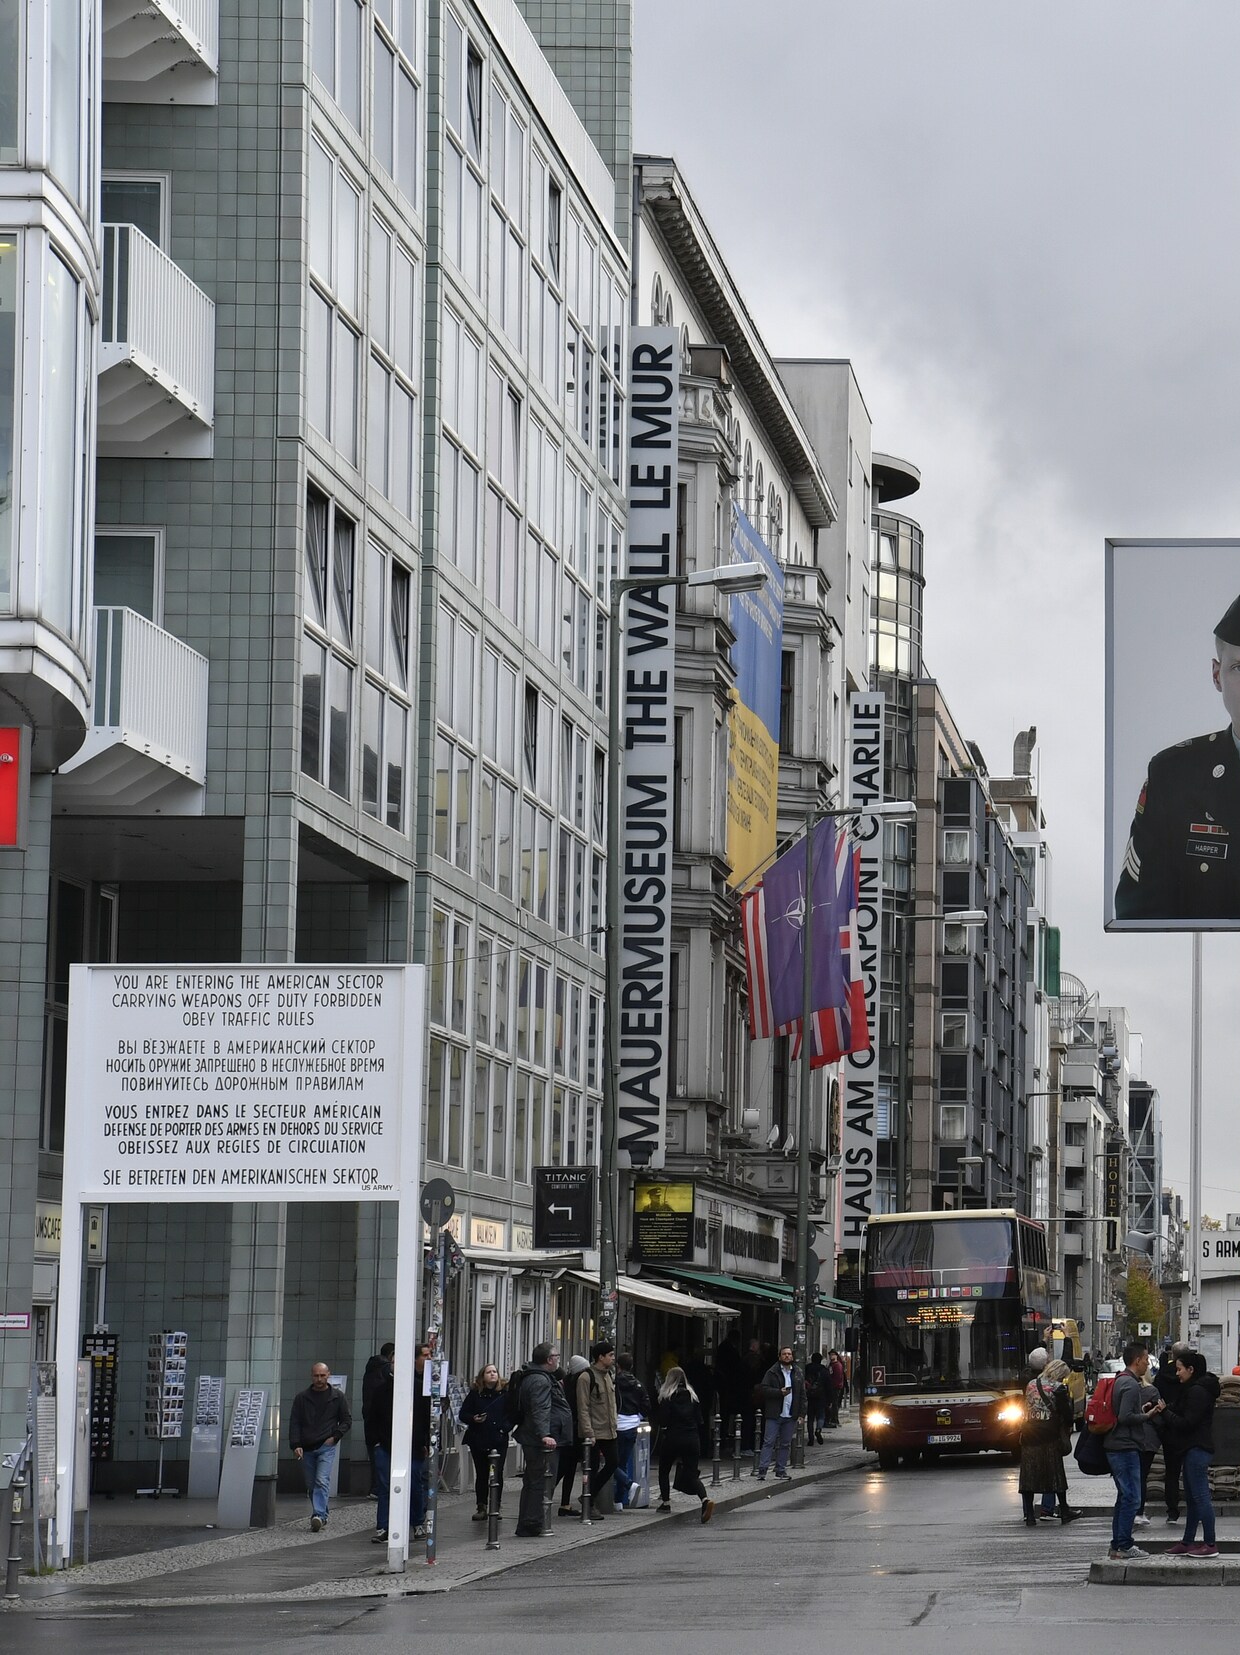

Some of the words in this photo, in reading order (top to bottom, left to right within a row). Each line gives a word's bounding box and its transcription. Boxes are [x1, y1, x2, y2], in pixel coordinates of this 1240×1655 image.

[631, 344, 673, 448] MUR
[631, 465, 671, 508] LE
[628, 533, 670, 655] WALL
[626, 670, 667, 749] THE
[852, 704, 880, 841] CHARLIE
[1195, 844, 1218, 854] HARPER
[619, 775, 668, 1149] MAUERMUSEUM
[114, 975, 138, 989] YOU
[146, 975, 168, 989] ARE
[177, 975, 233, 989] ENTERING
[241, 975, 259, 989] THE
[267, 975, 329, 989] AMERICAN
[337, 975, 383, 989] SECTOR
[113, 994, 176, 1008] CARRYING
[182, 994, 242, 1008] WEAPONS
[248, 994, 270, 1007] OFF
[278, 993, 307, 1007] DUTY
[314, 993, 381, 1007] FORBIDDEN
[183, 1012, 215, 1026] OBEY
[222, 1012, 270, 1026] TRAFFIC
[278, 1012, 314, 1026] RULES
[119, 1040, 137, 1054] ВЫ
[227, 1038, 325, 1054] АМЕРИКАНСКИЙ
[332, 1040, 375, 1054] СЕКТОР
[106, 1059, 145, 1072] НОСИТЬ
[149, 1058, 191, 1072] ОРУЖИЕ
[272, 1058, 346, 1072] НЕСЛУЖЕБНОЕ
[351, 1058, 384, 1072] ВРЕМЯ
[215, 1076, 288, 1091] ДОРОЖНЫМ
[296, 1077, 363, 1090] ПРАВИЛАМ
[105, 1105, 137, 1119] VOUS
[146, 1105, 189, 1119] ENTREZ
[197, 1104, 228, 1118] DANS
[236, 1105, 246, 1118] LE
[253, 1104, 306, 1118] SECTEUR
[847, 1080, 874, 1136] AM
[104, 1123, 146, 1136] DEFENSE
[150, 1123, 162, 1136] DE
[165, 1122, 201, 1136] PORTER
[205, 1122, 223, 1136] DES
[226, 1122, 259, 1136] ARMES
[263, 1122, 276, 1135] EN
[281, 1122, 319, 1135] DEHORS
[325, 1122, 338, 1135] DU
[342, 1122, 383, 1135] SERVICE
[118, 1140, 178, 1154] OBEISSEZ
[186, 1140, 210, 1154] AUX
[218, 1140, 259, 1154] REGLES
[268, 1140, 281, 1153] DE
[289, 1140, 365, 1153] CIRCULATION
[103, 1170, 121, 1185] SIE
[129, 1170, 186, 1185] BETRETEN
[193, 1169, 215, 1184] DEN
[221, 1169, 326, 1184] AMERIKANISCHEN
[333, 1168, 378, 1184] SEKTOR
[545, 1173, 586, 1181] TITANIC
[844, 1148, 873, 1236] HAUS
[1108, 1157, 1117, 1216] HOTE
[1203, 1241, 1210, 1258] S
[875, 1370, 883, 1383] 2
